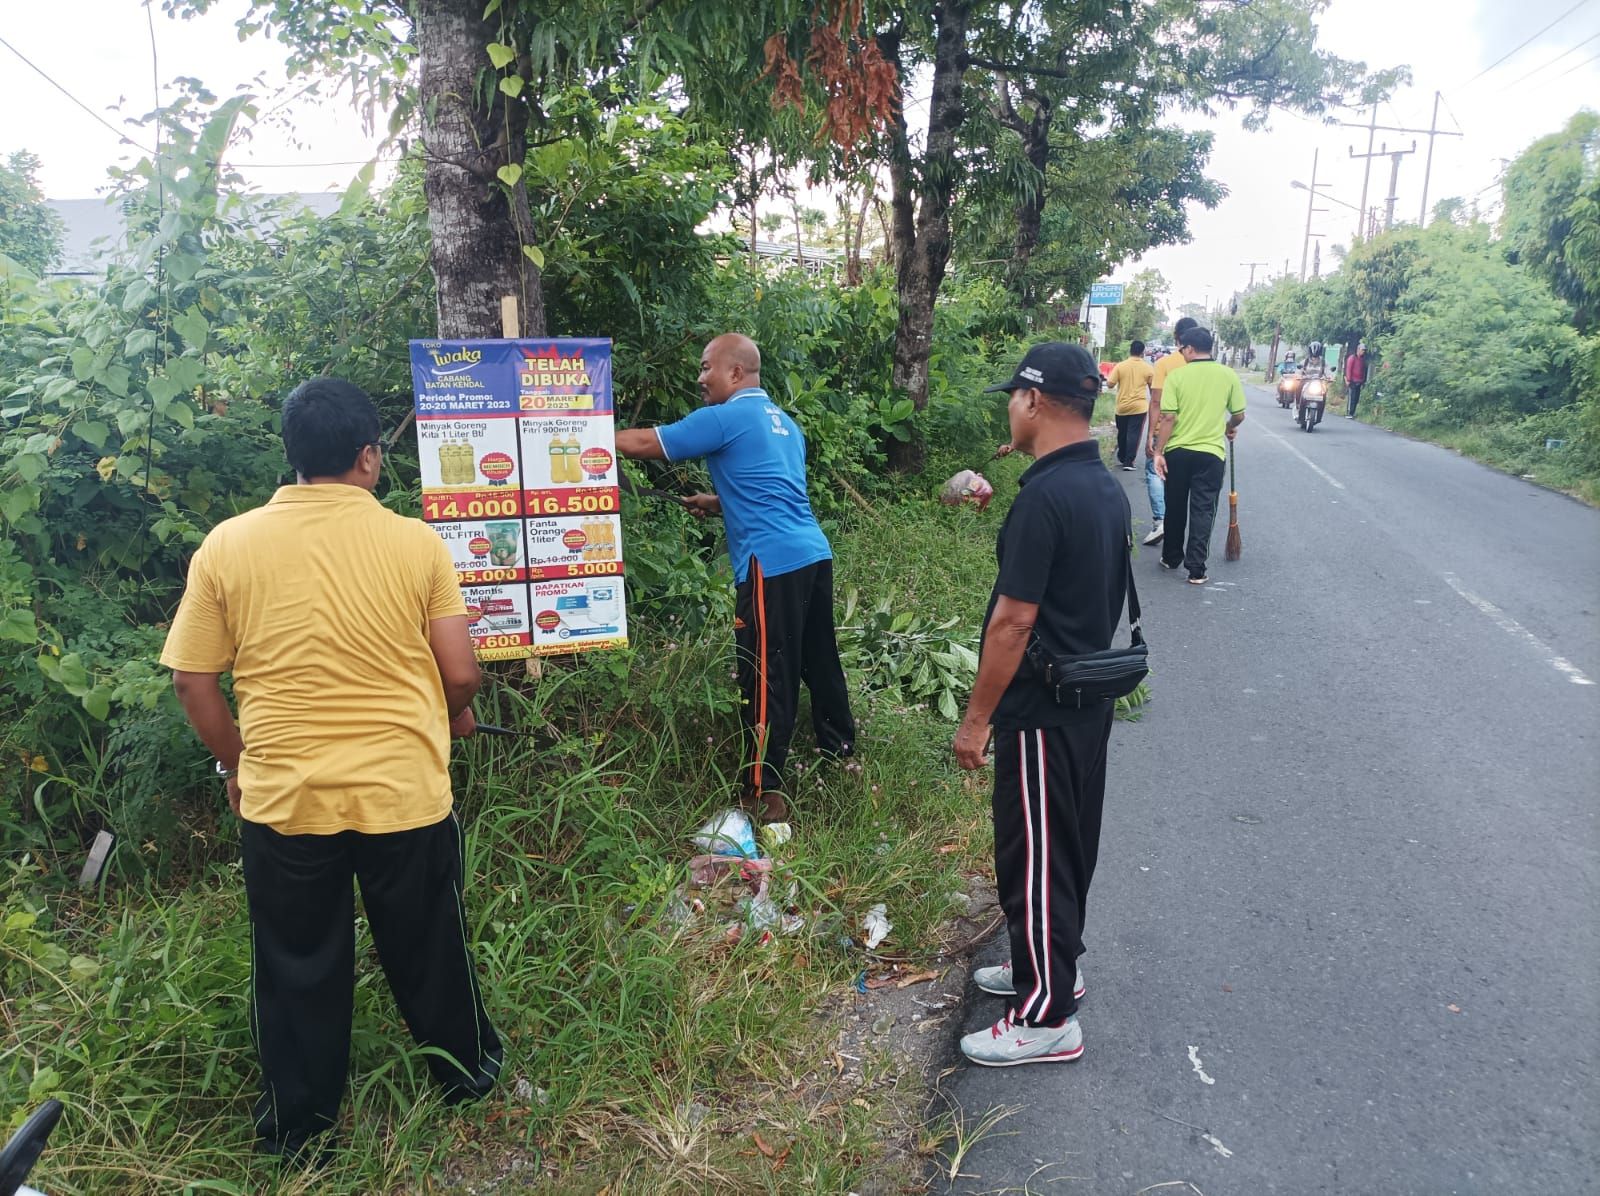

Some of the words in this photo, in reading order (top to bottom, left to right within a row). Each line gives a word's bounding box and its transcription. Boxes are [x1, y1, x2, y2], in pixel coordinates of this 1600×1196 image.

[524, 358, 585, 371] TELAH
[521, 373, 592, 386] DIBUKA
[418, 394, 456, 402] Periode
[521, 396, 546, 409] 20
[486, 400, 511, 409] 2023
[420, 422, 452, 431] Minyak
[453, 422, 487, 430] Goreng
[426, 499, 517, 519] 14.000
[528, 495, 614, 514] 16.500
[457, 530, 485, 539] FITRI
[530, 528, 566, 536] Orange
[567, 562, 618, 576] 5.000
[535, 582, 584, 591] DAPATKAN
